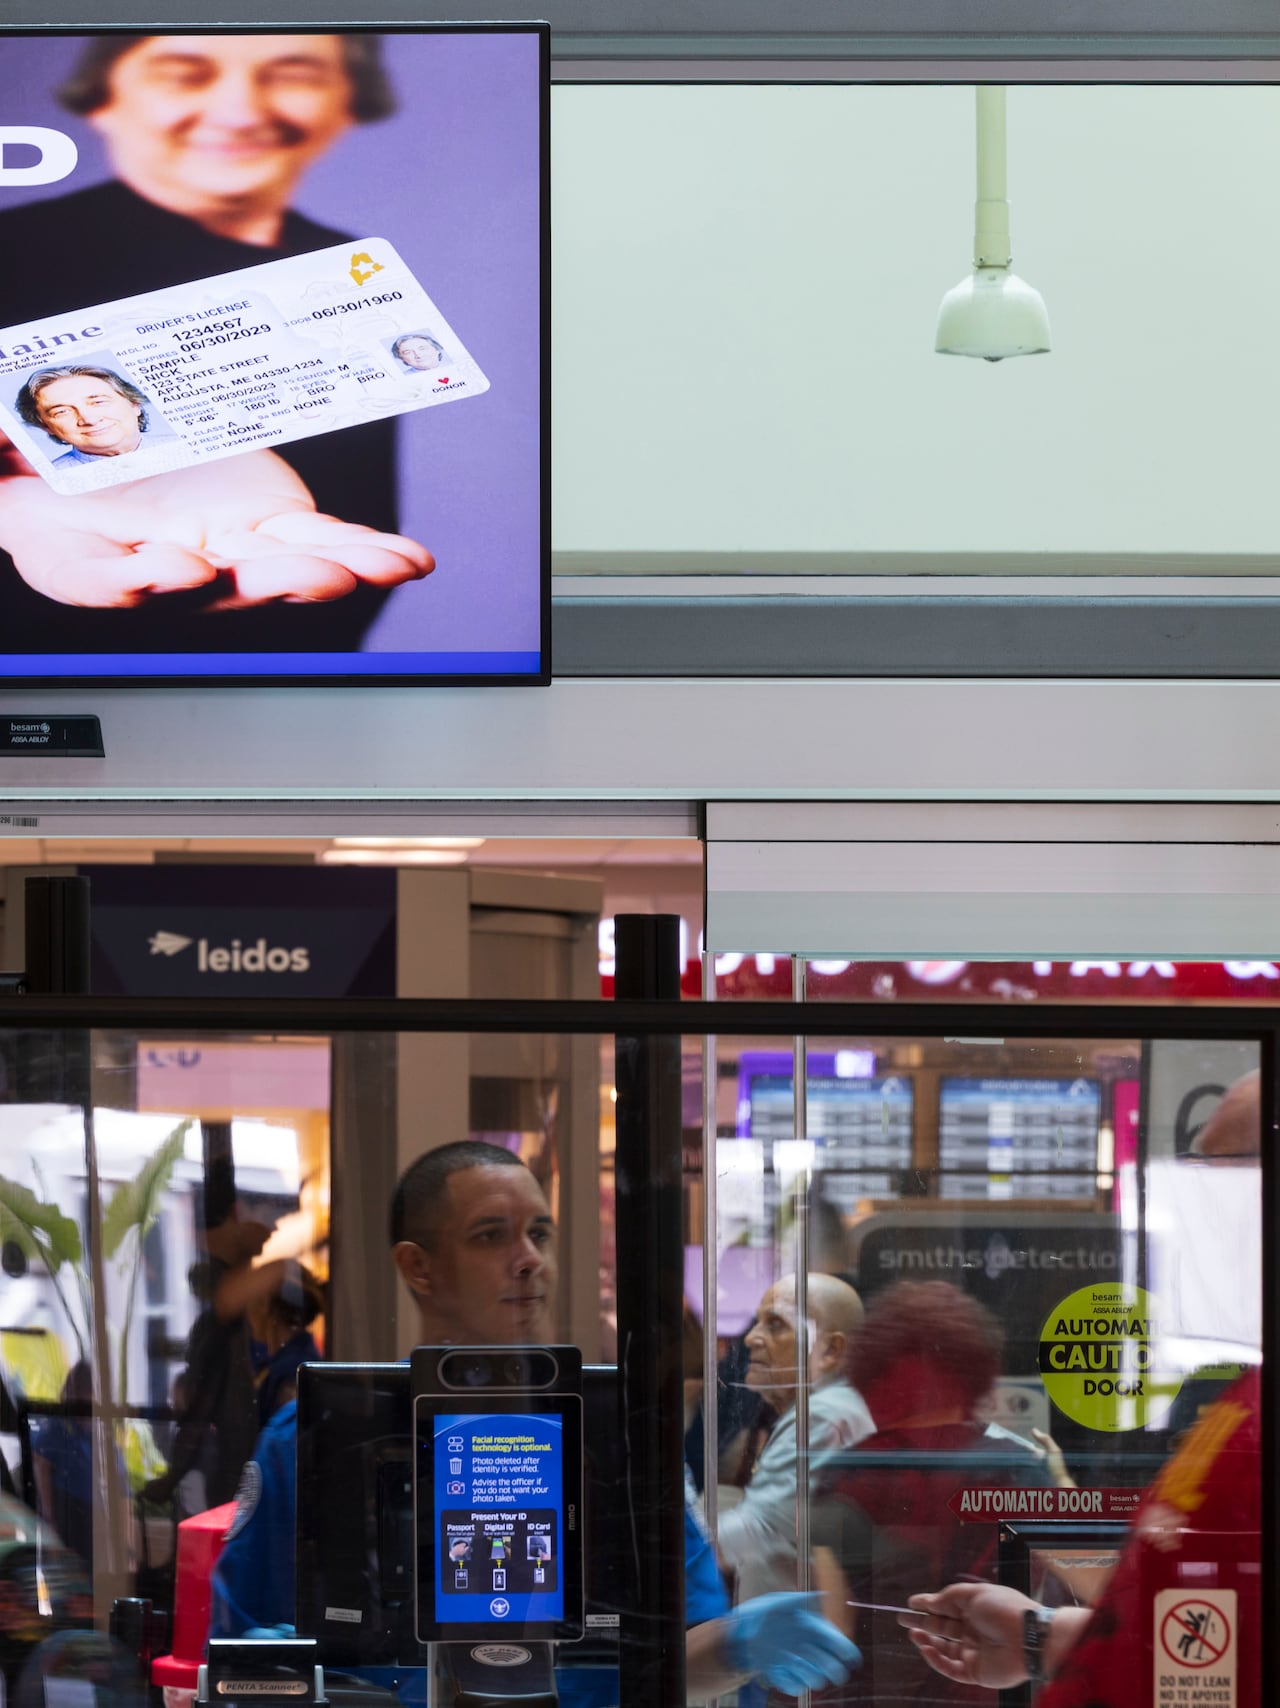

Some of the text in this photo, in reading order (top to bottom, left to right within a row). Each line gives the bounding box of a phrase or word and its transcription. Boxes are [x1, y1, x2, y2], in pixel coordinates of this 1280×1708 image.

[312, 291, 403, 320] 06/30/1960
[136, 300, 252, 335] DRIVER'S LICENSE
[172, 317, 242, 342] 1234567
[180, 324, 271, 352] 06/30/2029
[31, 351, 56, 360] State
[138, 353, 202, 374] SAMPLE
[338, 363, 350, 372] M
[145, 368, 183, 382] NICK
[152, 354, 270, 390] 123 STATE STREET
[357, 372, 385, 384] BRO
[162, 358, 323, 403] AUGUSTA, ME 04330-1234
[157, 385, 181, 396] APT
[211, 382, 276, 403] 06/30/2023
[307, 384, 335, 396] BRO
[432, 381, 466, 393] DONOR
[244, 402, 265, 412] 180
[293, 397, 332, 411] NONE
[227, 422, 265, 437] NONE
[10, 722, 41, 732] besam
[197, 938, 310, 972] leidos
[1092, 1292, 1122, 1301] besam
[1083, 1379, 1144, 1397] DOOR
[471, 1436, 535, 1444] Facial recognition
[472, 1444, 512, 1453] technology
[472, 1457, 540, 1465] Photo deleted after
[472, 1465, 500, 1474] identity
[960, 1490, 1103, 1513] AUTOMATIC DOOR
[471, 1513, 499, 1521] Present
[518, 1512, 527, 1520] ID
[484, 1523, 505, 1531] Digital
[226, 1683, 256, 1691] PENTA
[1160, 1675, 1231, 1688] DO NOT LEAN
[1160, 1690, 1231, 1700] NO TE APOYES
